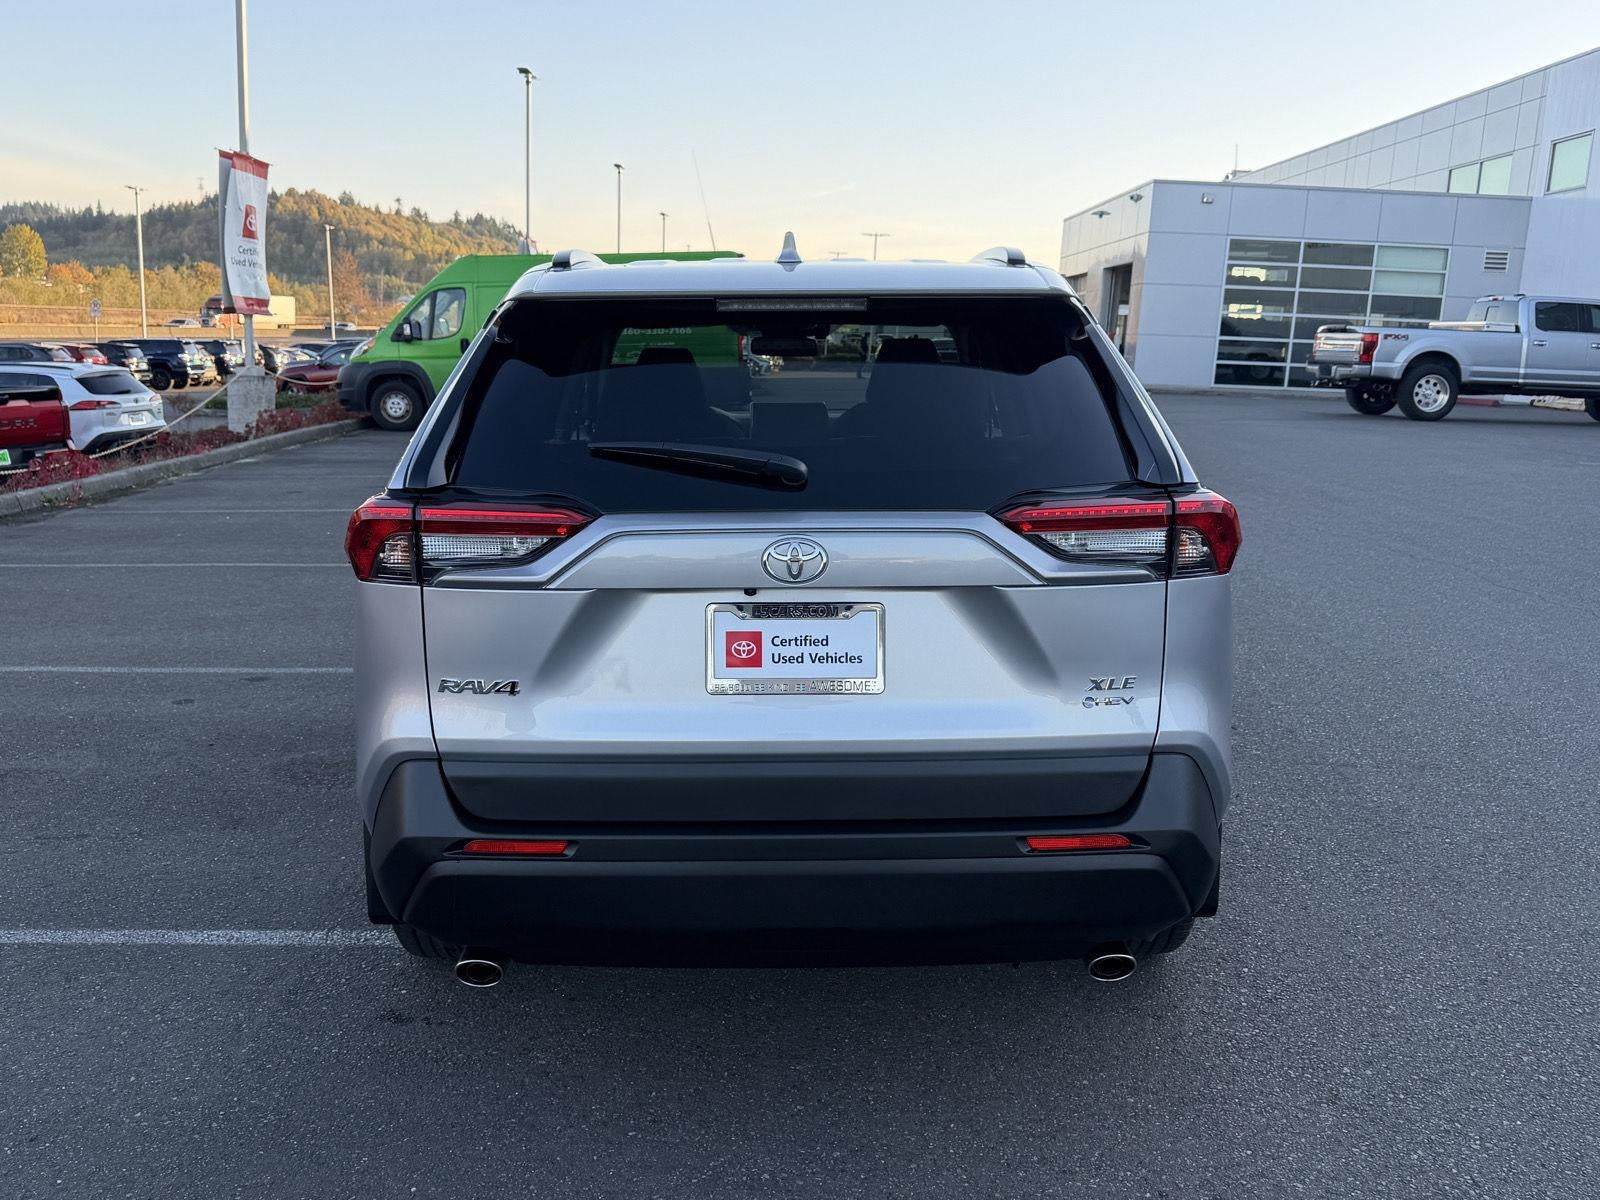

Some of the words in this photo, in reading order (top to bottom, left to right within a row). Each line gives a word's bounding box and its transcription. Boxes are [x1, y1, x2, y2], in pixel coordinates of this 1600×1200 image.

[771, 635, 829, 647] Certified
[771, 652, 804, 664] Used
[808, 652, 863, 664] Vehicles
[437, 678, 520, 696] RAV4
[1085, 675, 1137, 691] XLE
